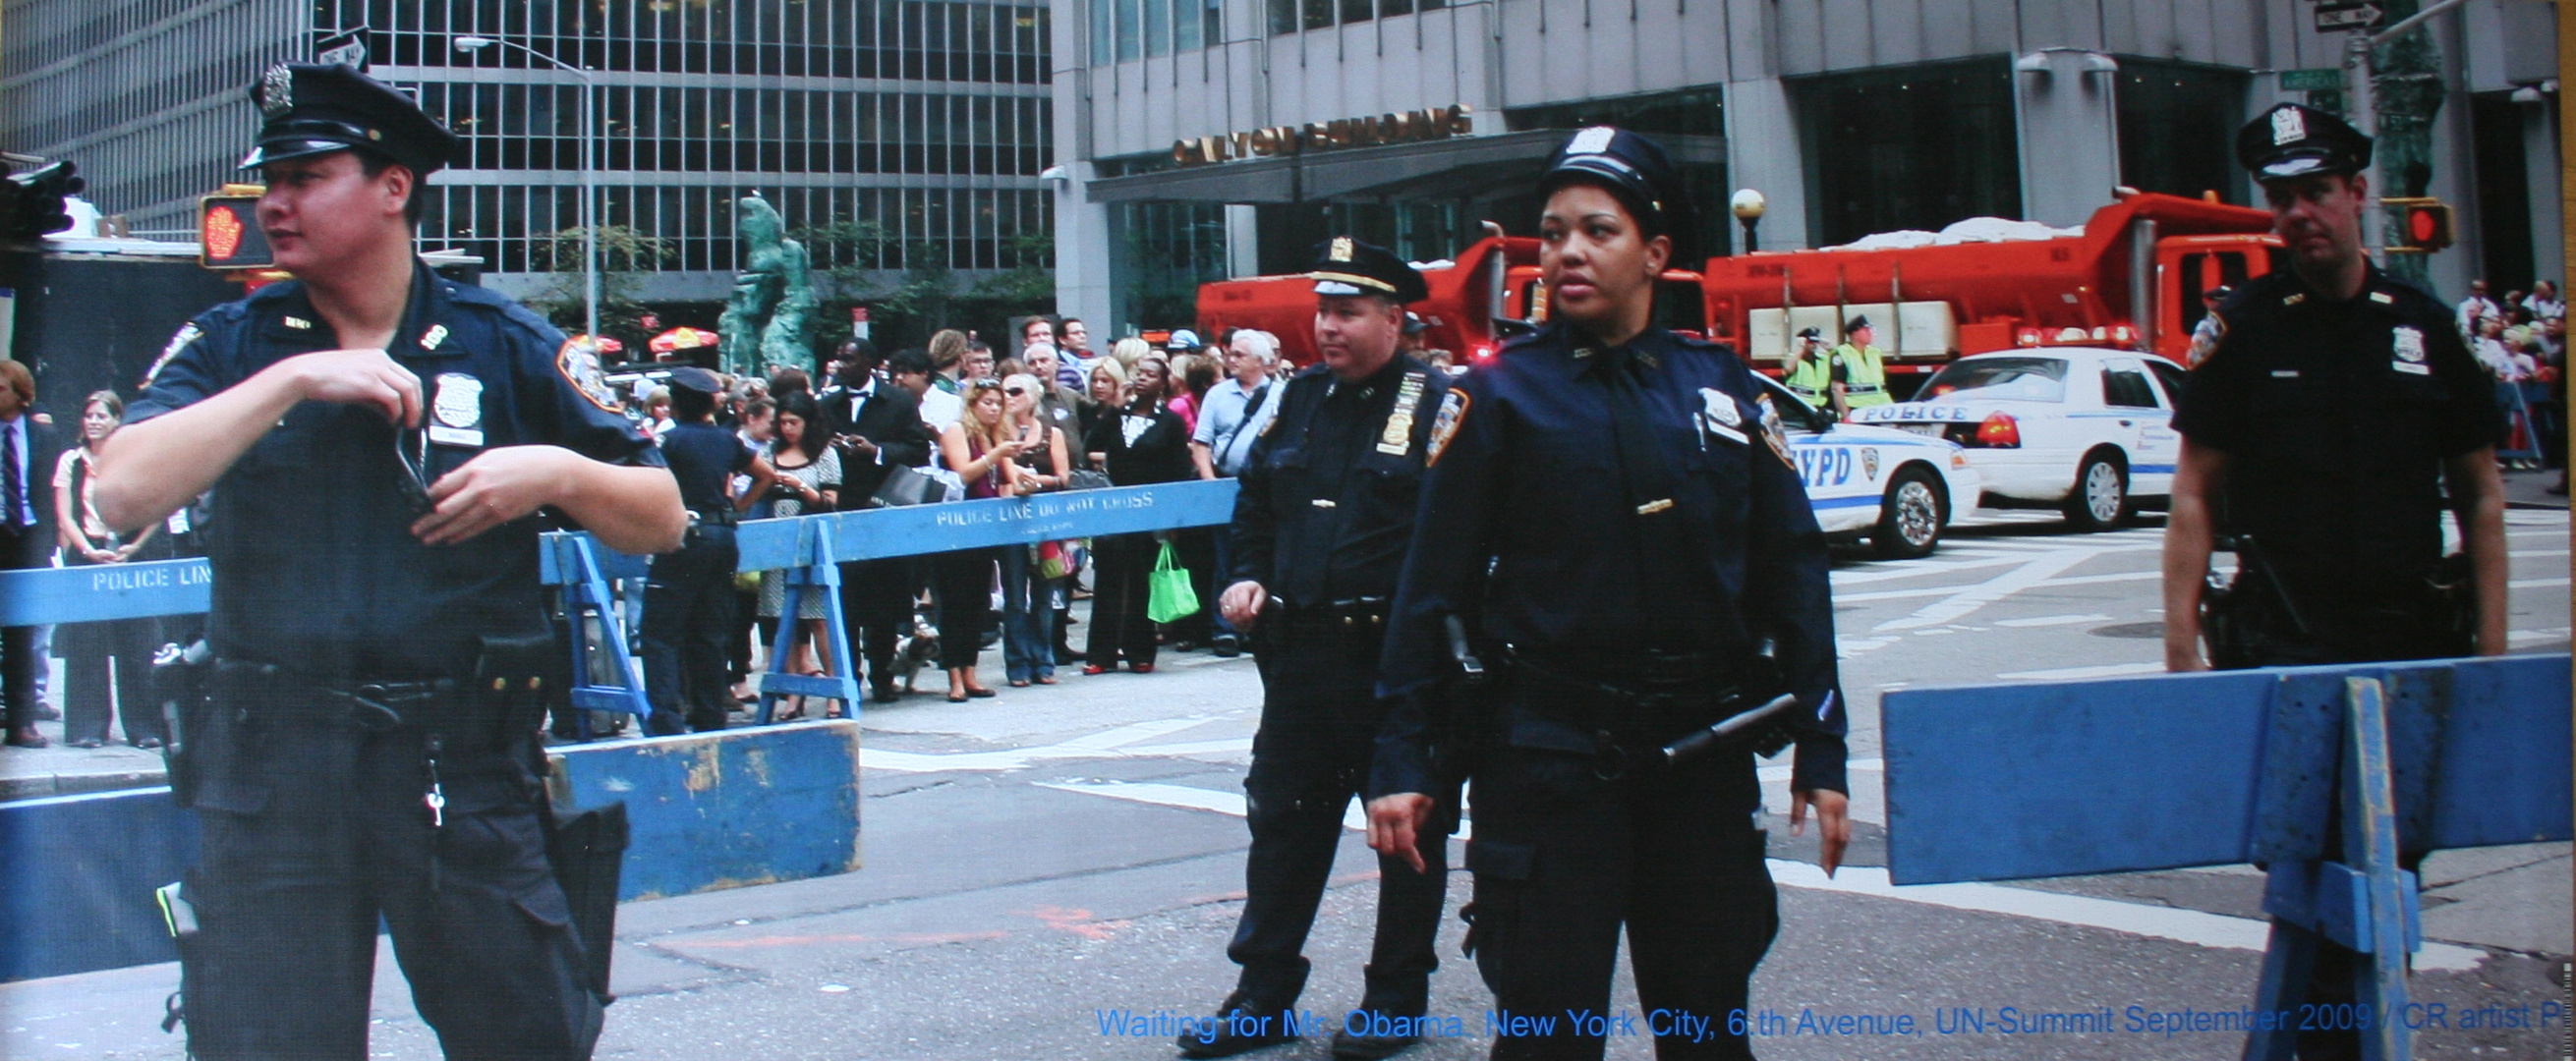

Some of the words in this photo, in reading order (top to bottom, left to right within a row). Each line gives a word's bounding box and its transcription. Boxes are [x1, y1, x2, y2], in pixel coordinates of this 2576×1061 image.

[1304, 104, 1472, 147] BUILDING
[1864, 406, 1969, 421] POLICE
[1793, 447, 1851, 486] YPD
[937, 510, 993, 526] POLICE
[1000, 503, 1033, 522] LINE
[93, 568, 169, 590] POLICE
[180, 565, 212, 586] LIN
